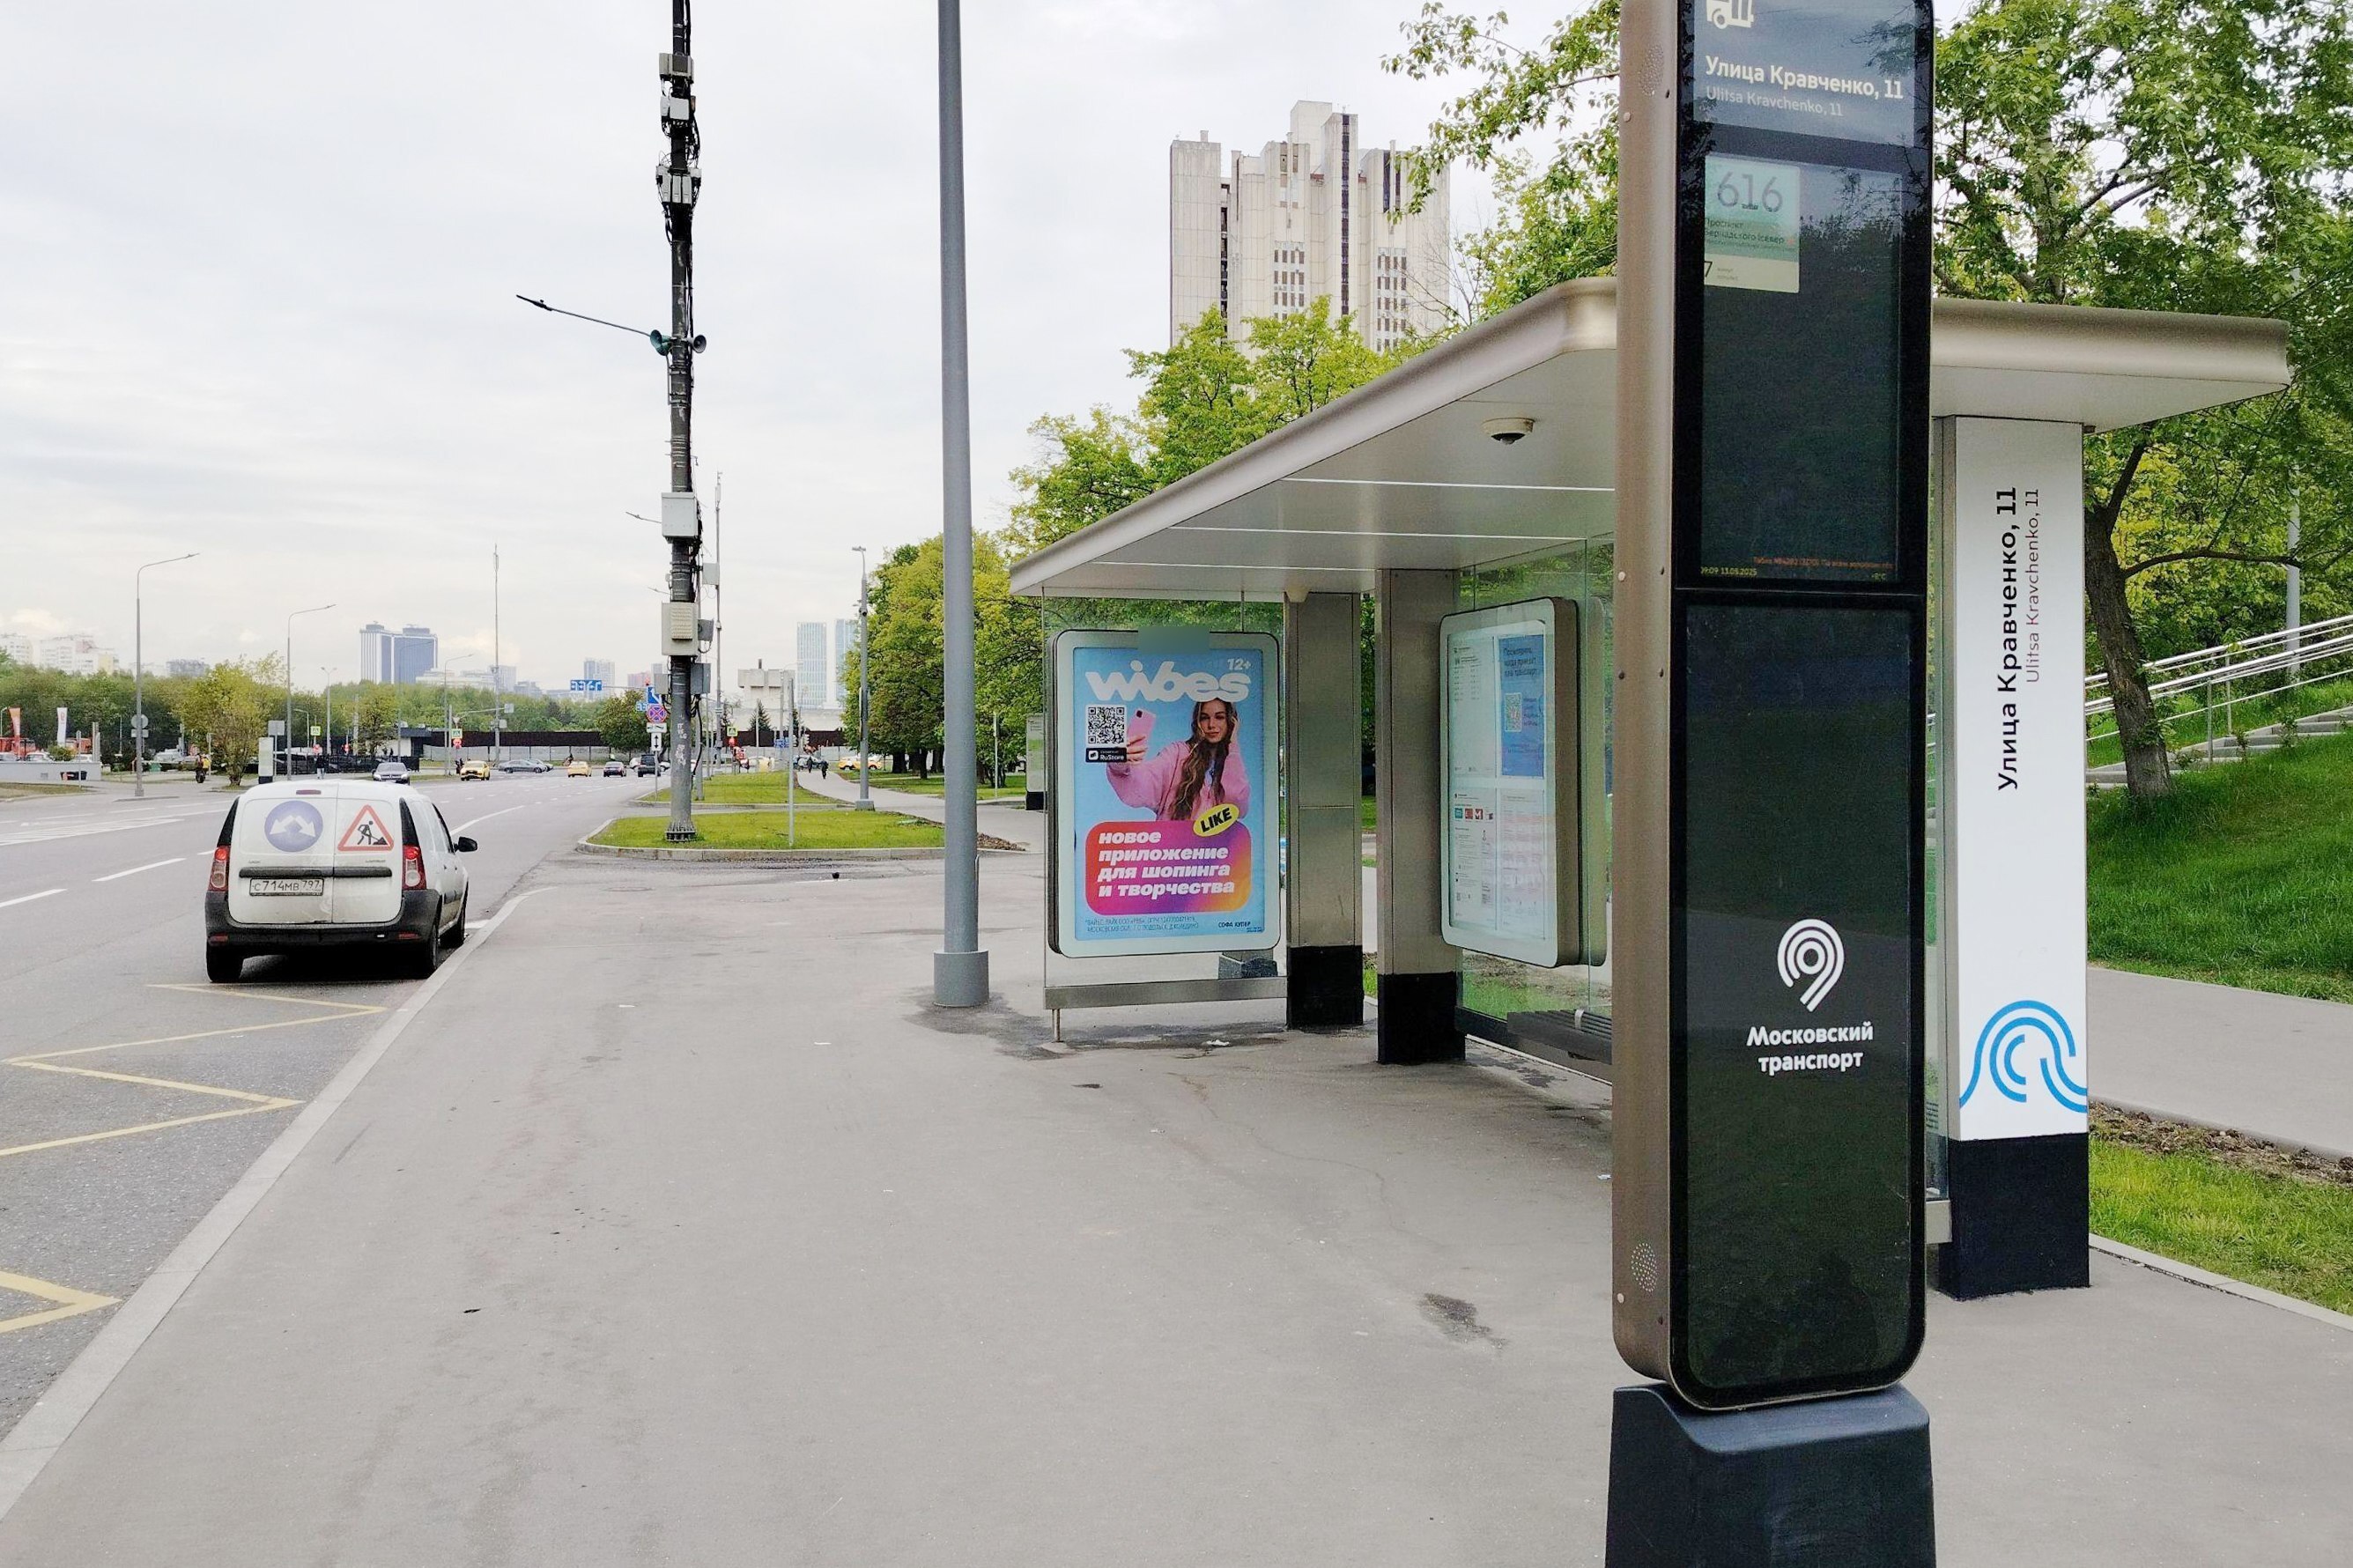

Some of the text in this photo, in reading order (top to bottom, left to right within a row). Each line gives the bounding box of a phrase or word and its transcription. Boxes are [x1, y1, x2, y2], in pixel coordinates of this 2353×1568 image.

[1706, 55, 1904, 100] Улица Кравченко, 11
[1706, 85, 1844, 116] Ulitsa Kravchenko, 11
[1717, 171, 1783, 213] 616
[2025, 489, 2041, 683] Ulitsa Kravchenko, 11
[1996, 487, 2022, 791] Улица Кравченко, 11
[1227, 658, 1252, 671] 12+
[1084, 660, 1252, 703] wibes
[1201, 807, 1232, 833] LIKE
[1099, 831, 1162, 844] новое
[1098, 847, 1229, 866] приложение
[1097, 864, 1231, 882] для шопинга
[1099, 881, 1235, 899] и творчества
[1746, 1021, 1874, 1046] Московский
[1758, 1052, 1864, 1076] транспорт
